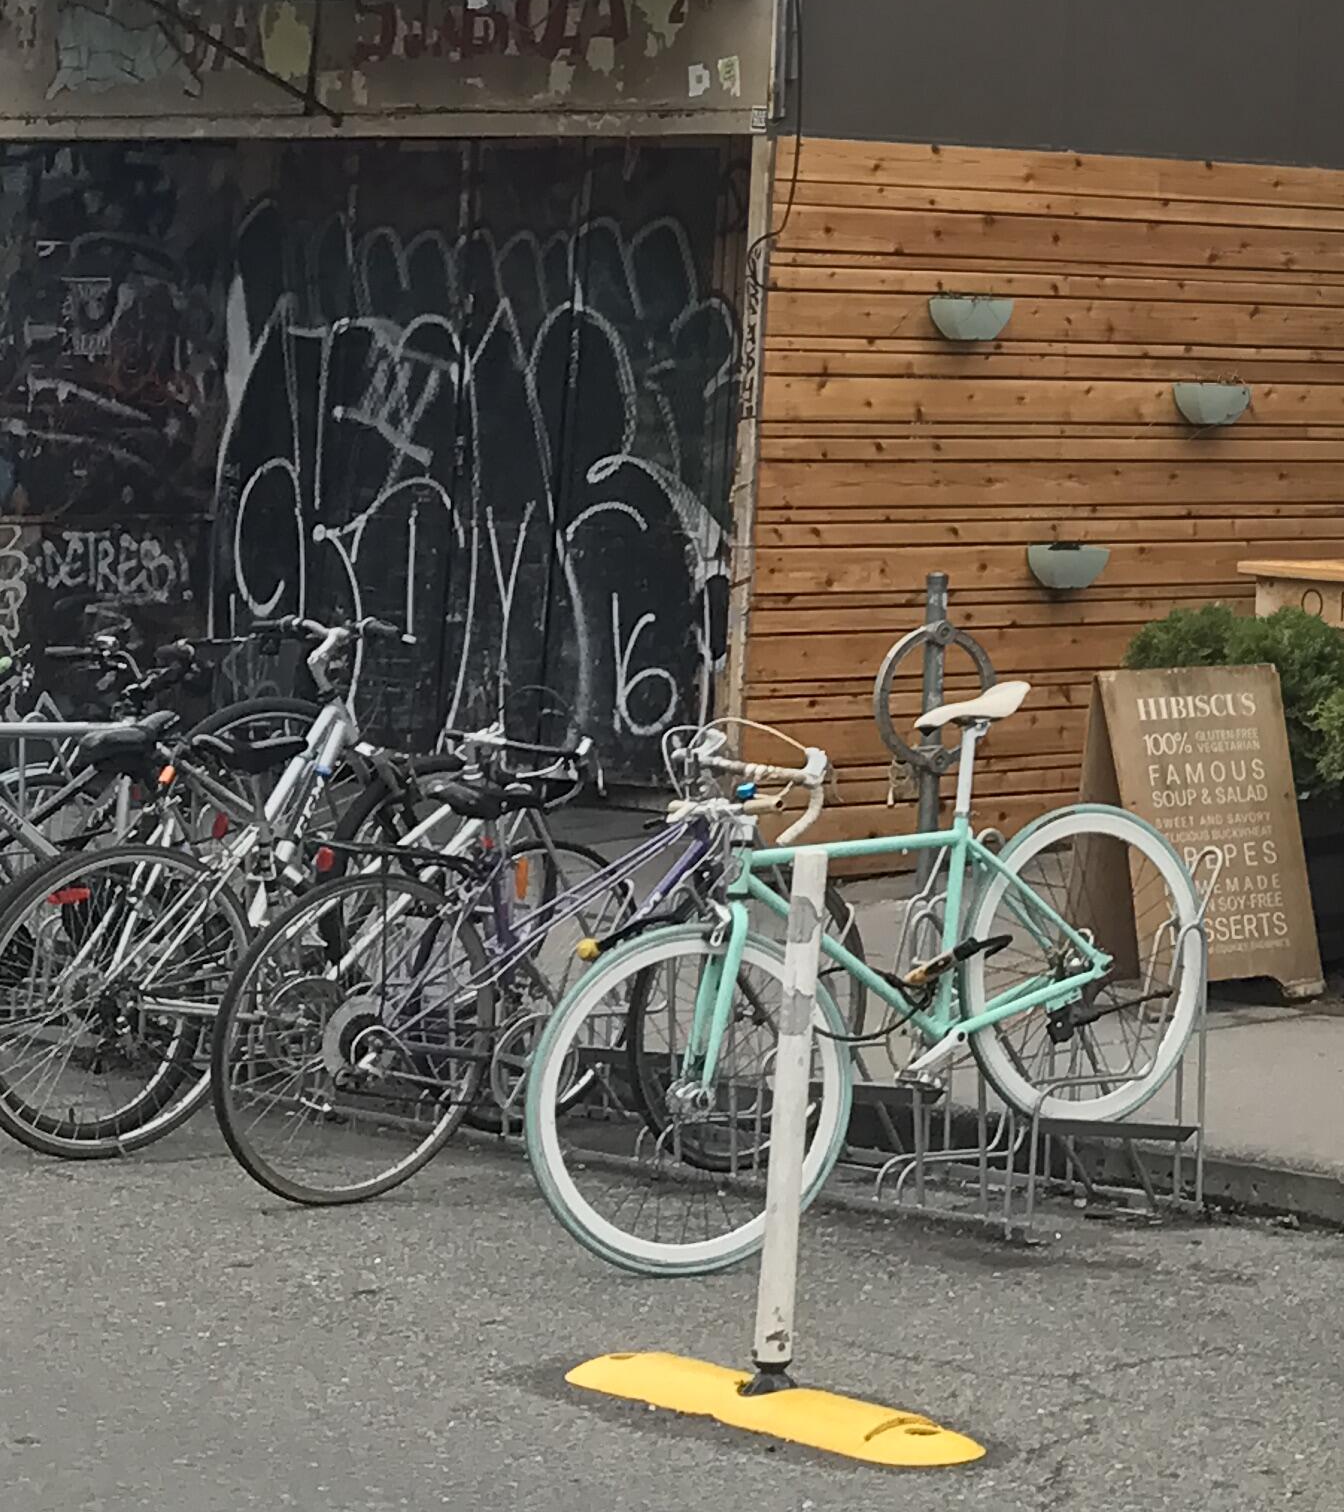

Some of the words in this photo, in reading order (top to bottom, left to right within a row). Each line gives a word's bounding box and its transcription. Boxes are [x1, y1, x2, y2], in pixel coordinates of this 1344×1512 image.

[1136, 692, 1257, 721] HIBISCUS
[1143, 731, 1193, 756] 100%
[1195, 739, 1261, 754] VEGETARIAN
[1148, 758, 1266, 786] FAMOUS
[1152, 789, 1198, 808] SOUP
[1200, 787, 1213, 805] &
[1215, 784, 1269, 804] SALAD
[1155, 816, 1195, 830] SWEET
[1199, 814, 1223, 826] AND
[1226, 810, 1272, 825] SAVORY
[1184, 840, 1278, 870] REPES
[1164, 873, 1282, 897] MEMADE
[1168, 912, 1289, 946] SSERTS
